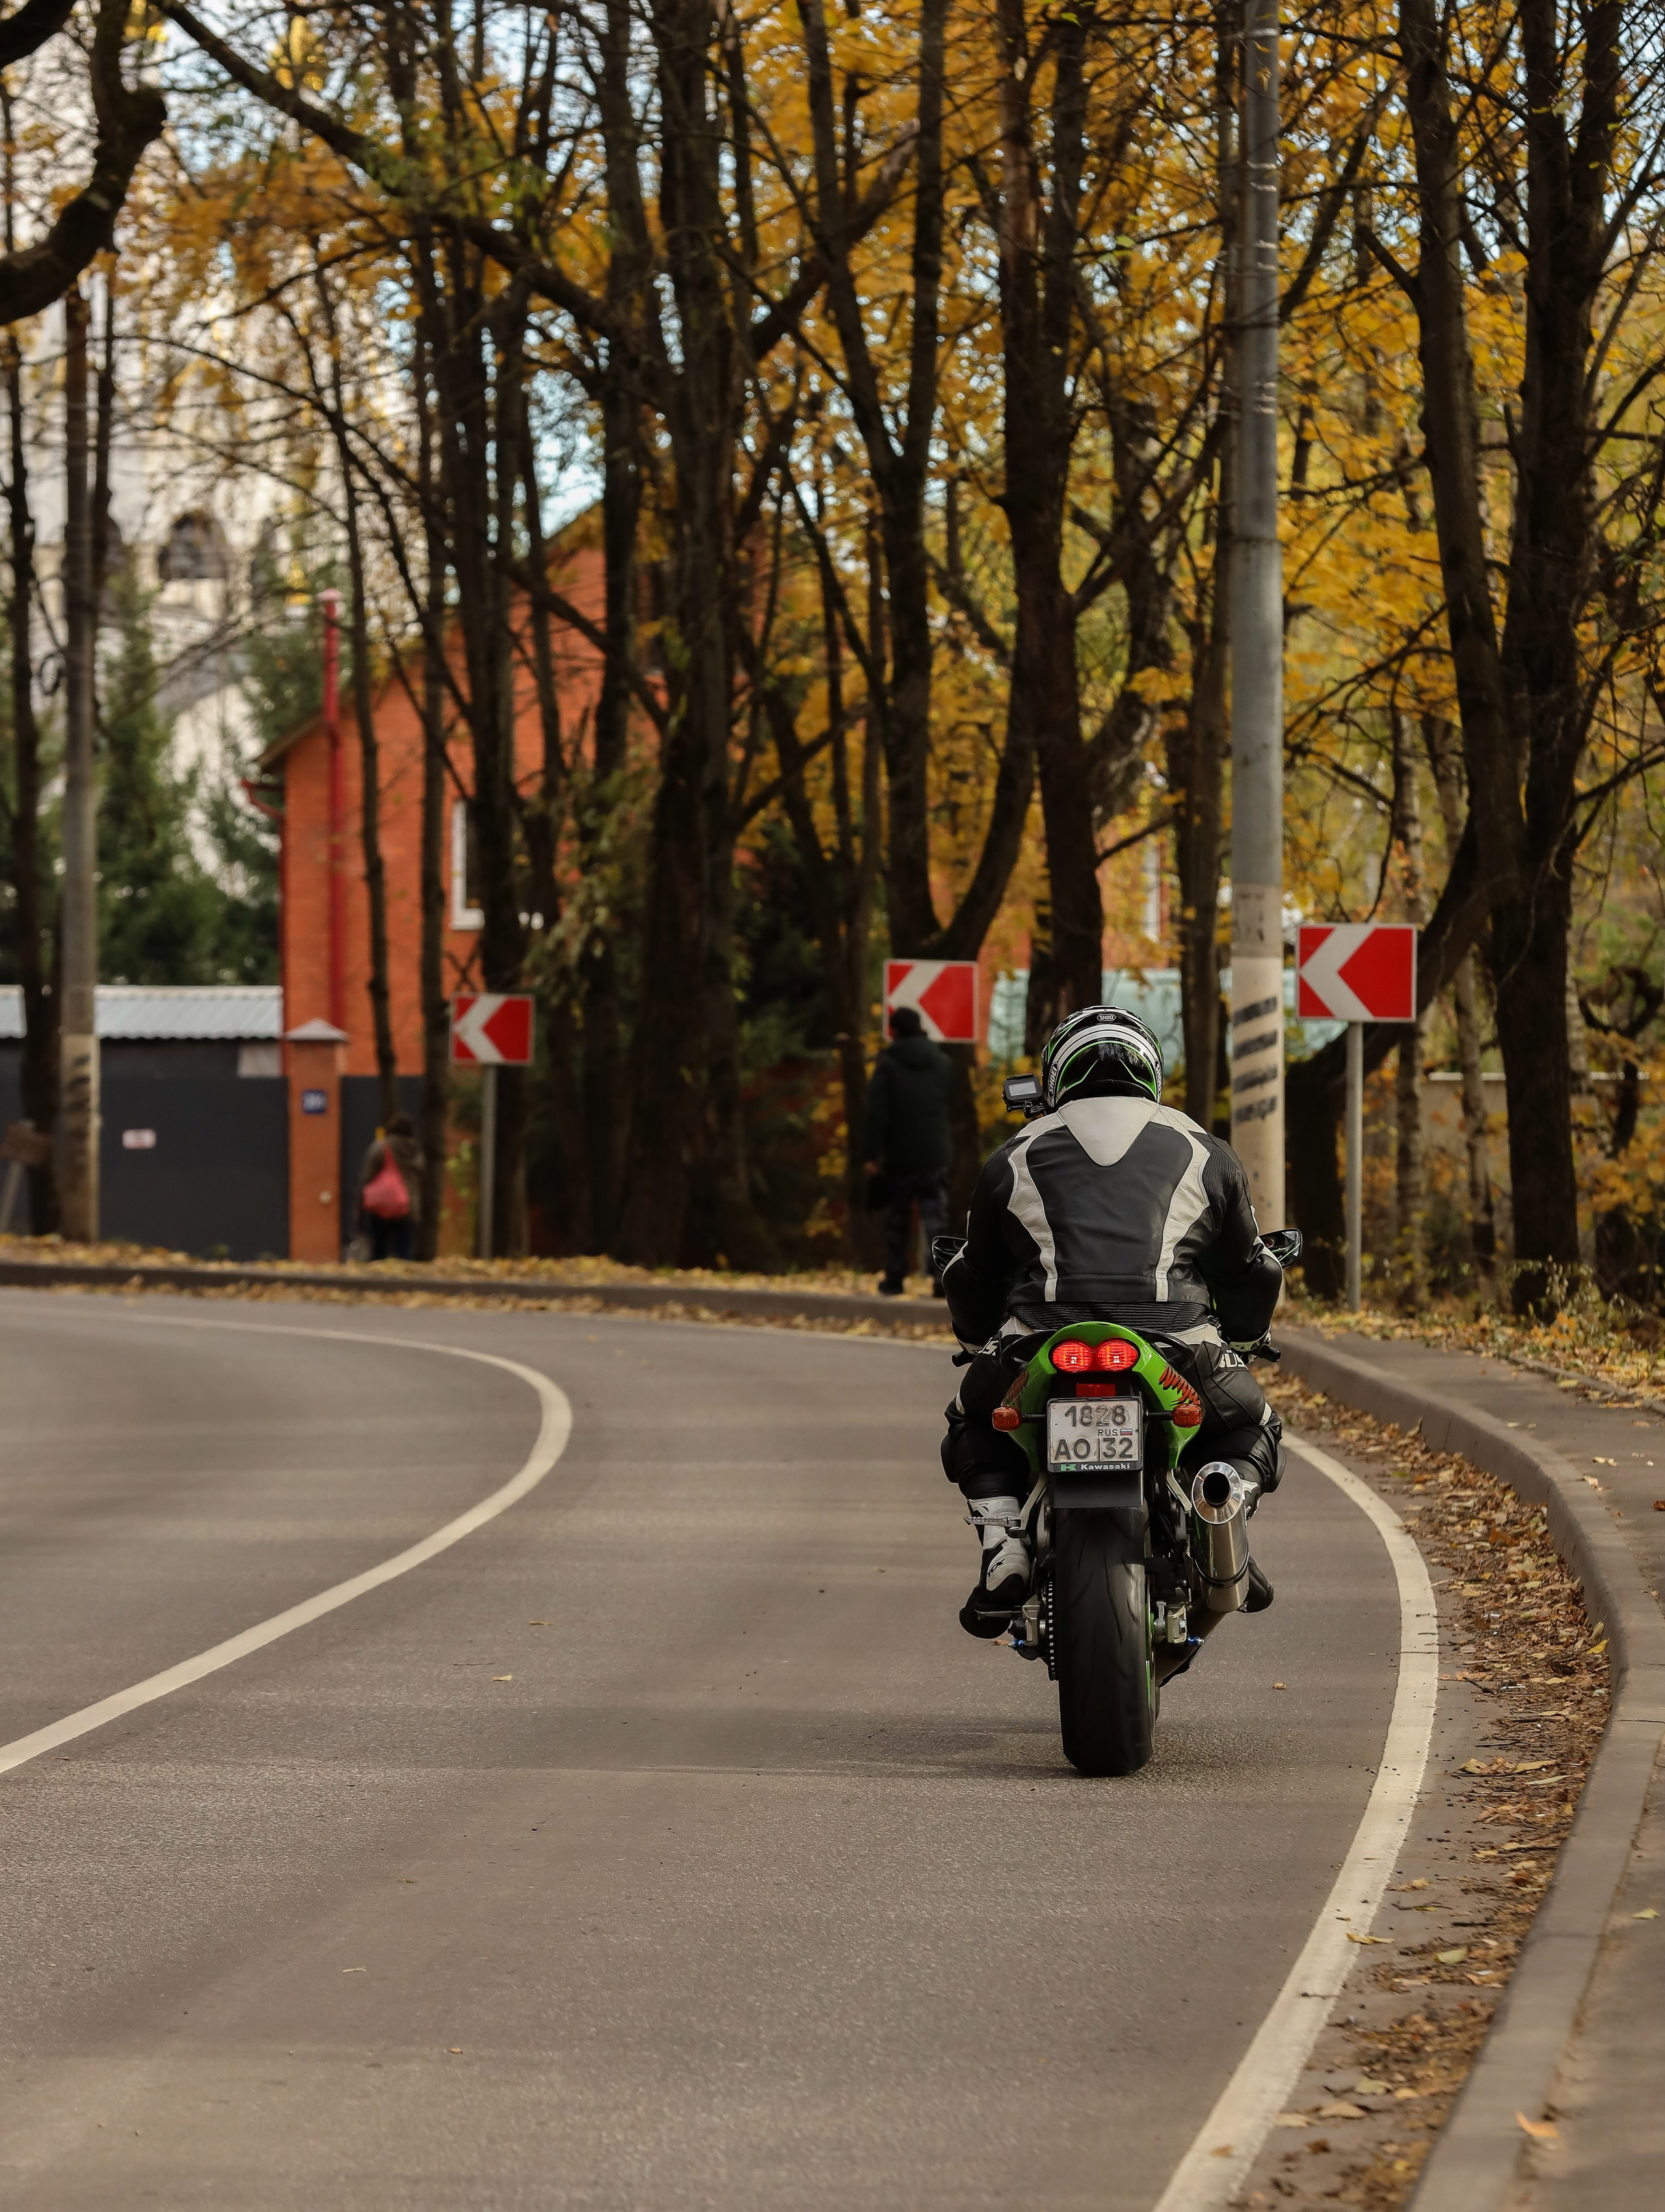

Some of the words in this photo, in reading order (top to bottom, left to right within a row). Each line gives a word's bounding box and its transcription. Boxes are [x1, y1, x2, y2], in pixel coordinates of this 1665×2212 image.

[1048, 1066, 1058, 1095] SHOEI
[1065, 1405, 1126, 1426] 1828
[1054, 1438, 1091, 1459] AO
[1103, 1438, 1133, 1458] 32
